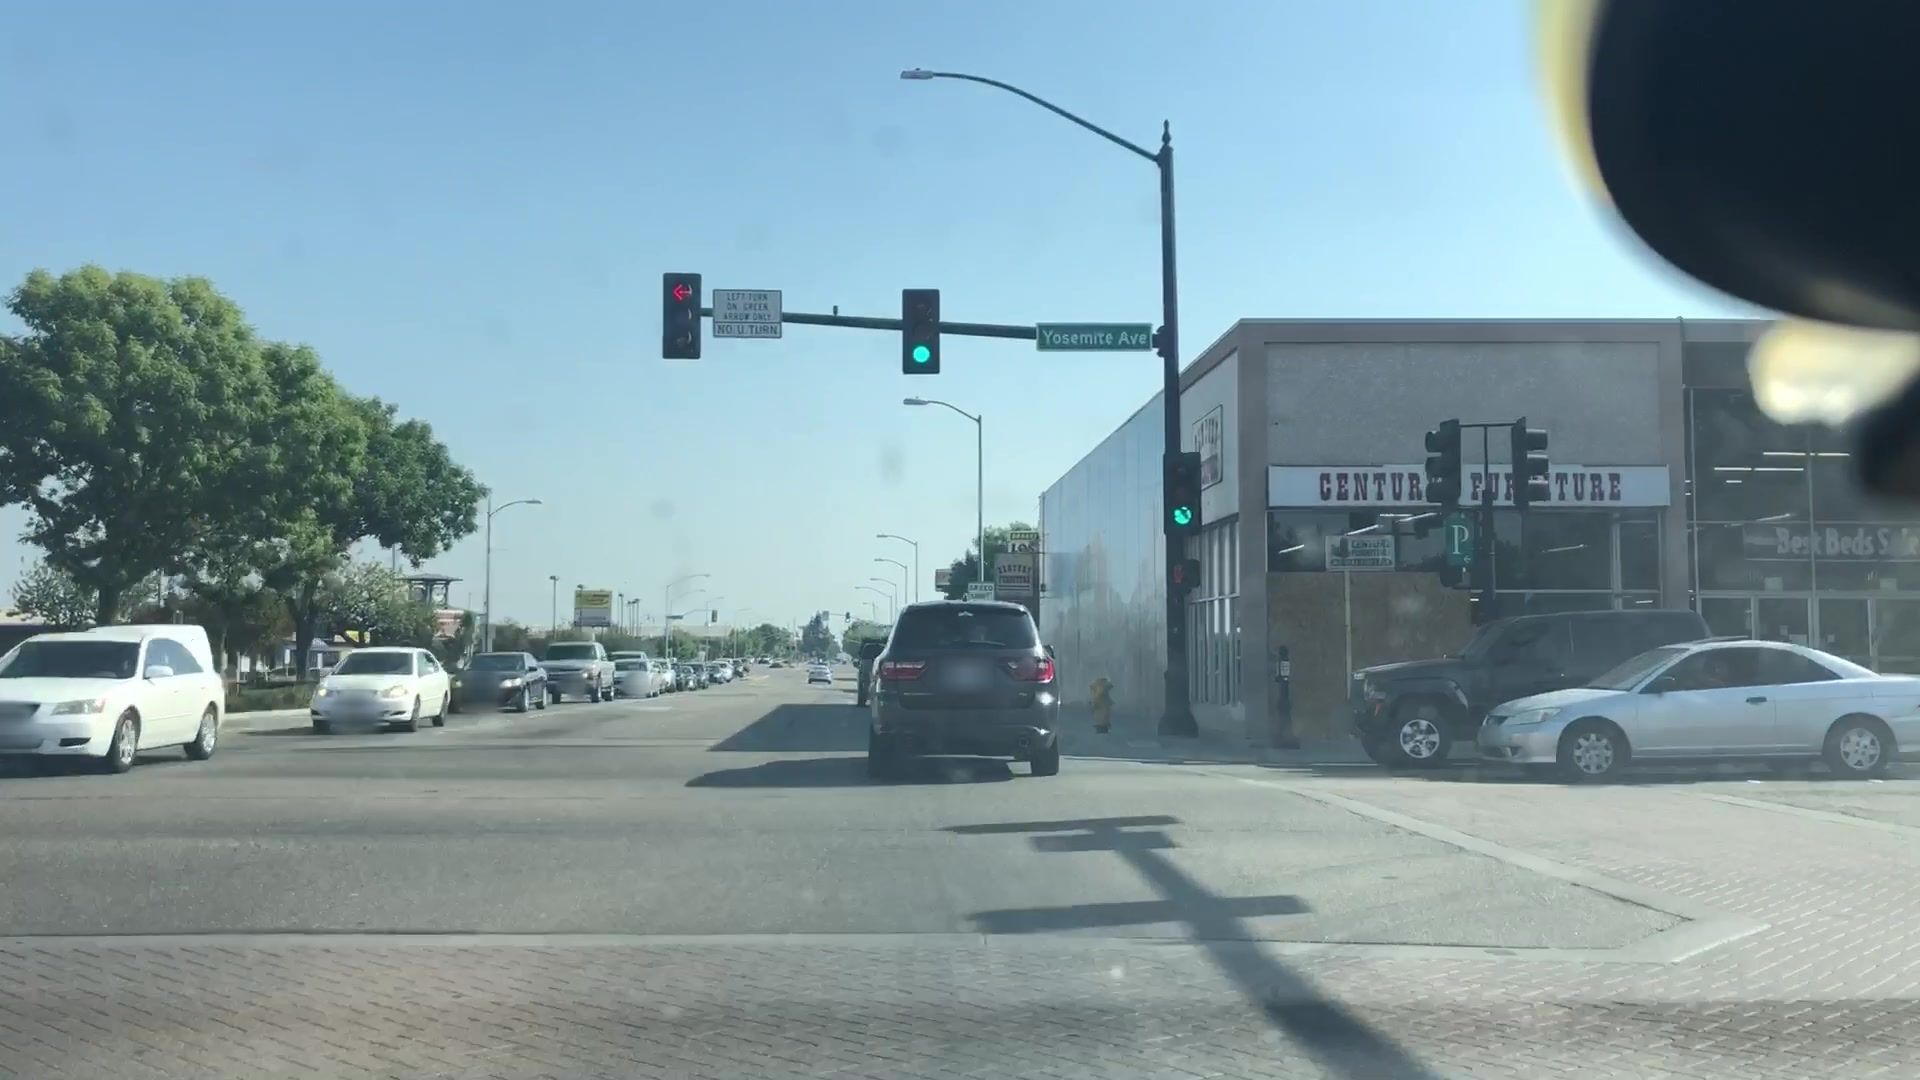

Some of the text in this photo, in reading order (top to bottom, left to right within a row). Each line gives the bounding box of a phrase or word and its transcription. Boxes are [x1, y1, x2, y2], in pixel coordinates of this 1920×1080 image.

[727, 292, 768, 301] LEFT TURN
[727, 302, 768, 311] ON GREEN
[724, 312, 770, 321] ARROW ONLY
[717, 325, 778, 335] NO U TURN
[1042, 329, 1147, 346] Yosemite Ave
[1319, 472, 1621, 501] CENTUR FURTURE
[1451, 525, 1469, 555] P
[1776, 527, 1821, 555] Best
[1826, 527, 1875, 556] Beds
